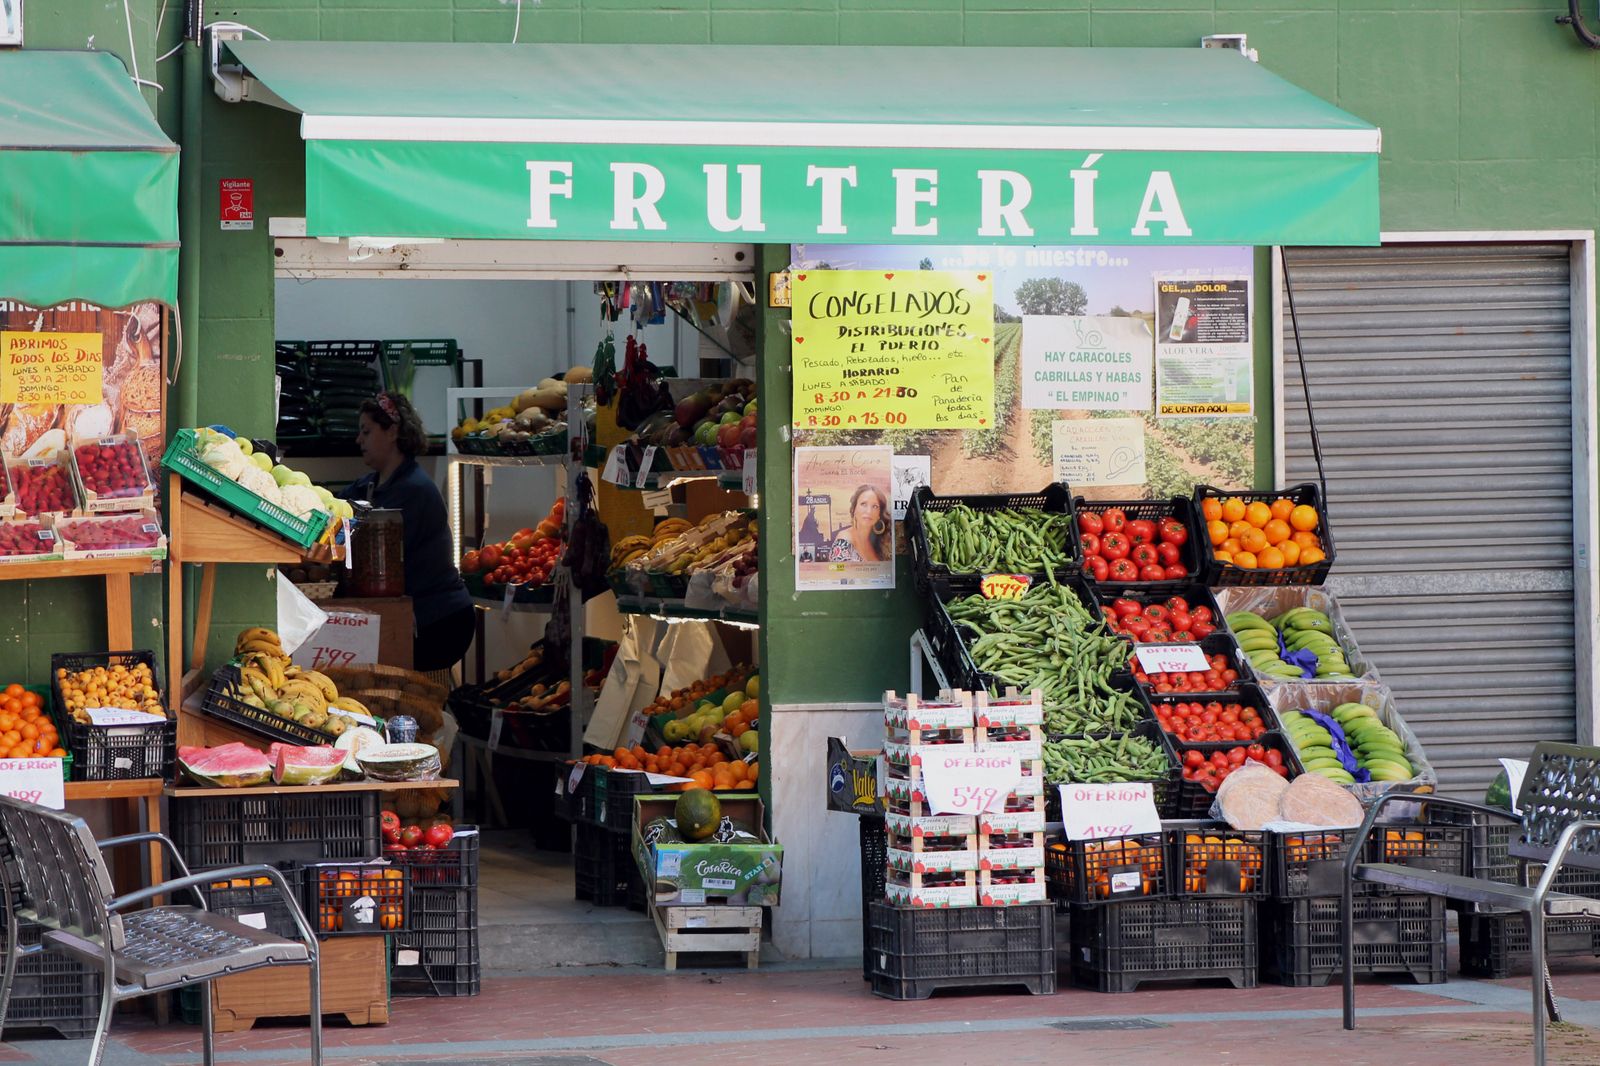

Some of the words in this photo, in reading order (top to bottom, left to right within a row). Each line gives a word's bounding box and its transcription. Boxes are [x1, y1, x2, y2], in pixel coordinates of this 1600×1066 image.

[222, 181, 251, 189] Vigilante
[525, 153, 1192, 237] FRUTERÍA
[1161, 284, 1180, 293] GEL
[1195, 284, 1227, 293] DOLOR
[808, 288, 971, 320] CONGELADOS
[837, 322, 969, 339] DISTRIBUCIONES
[10, 338, 68, 350] ABRIMOS
[850, 342, 865, 354] EL
[9, 353, 45, 365] TODOS
[51, 351, 70, 364] LOS
[1044, 351, 1065, 363] HAY
[1069, 352, 1132, 363] CARACOLES
[12, 366, 38, 376] LUNES
[46, 375, 52, 384] A
[1034, 371, 1093, 382] CABRILLAS
[1096, 371, 1103, 382] Y
[1106, 372, 1142, 383] HABAS
[802, 381, 832, 392] LUNES
[839, 379, 847, 388] A
[950, 385, 963, 393] de
[44, 393, 51, 401] A
[856, 391, 867, 399] A
[1056, 391, 1069, 402] EL
[1072, 391, 1120, 402] EMPINAO
[1161, 405, 1172, 414] DE
[1175, 405, 1205, 414] VENTA
[847, 415, 857, 424] A
[805, 496, 813, 505] 28
[853, 769, 876, 799] Valle
[743, 865, 764, 880] STAR
